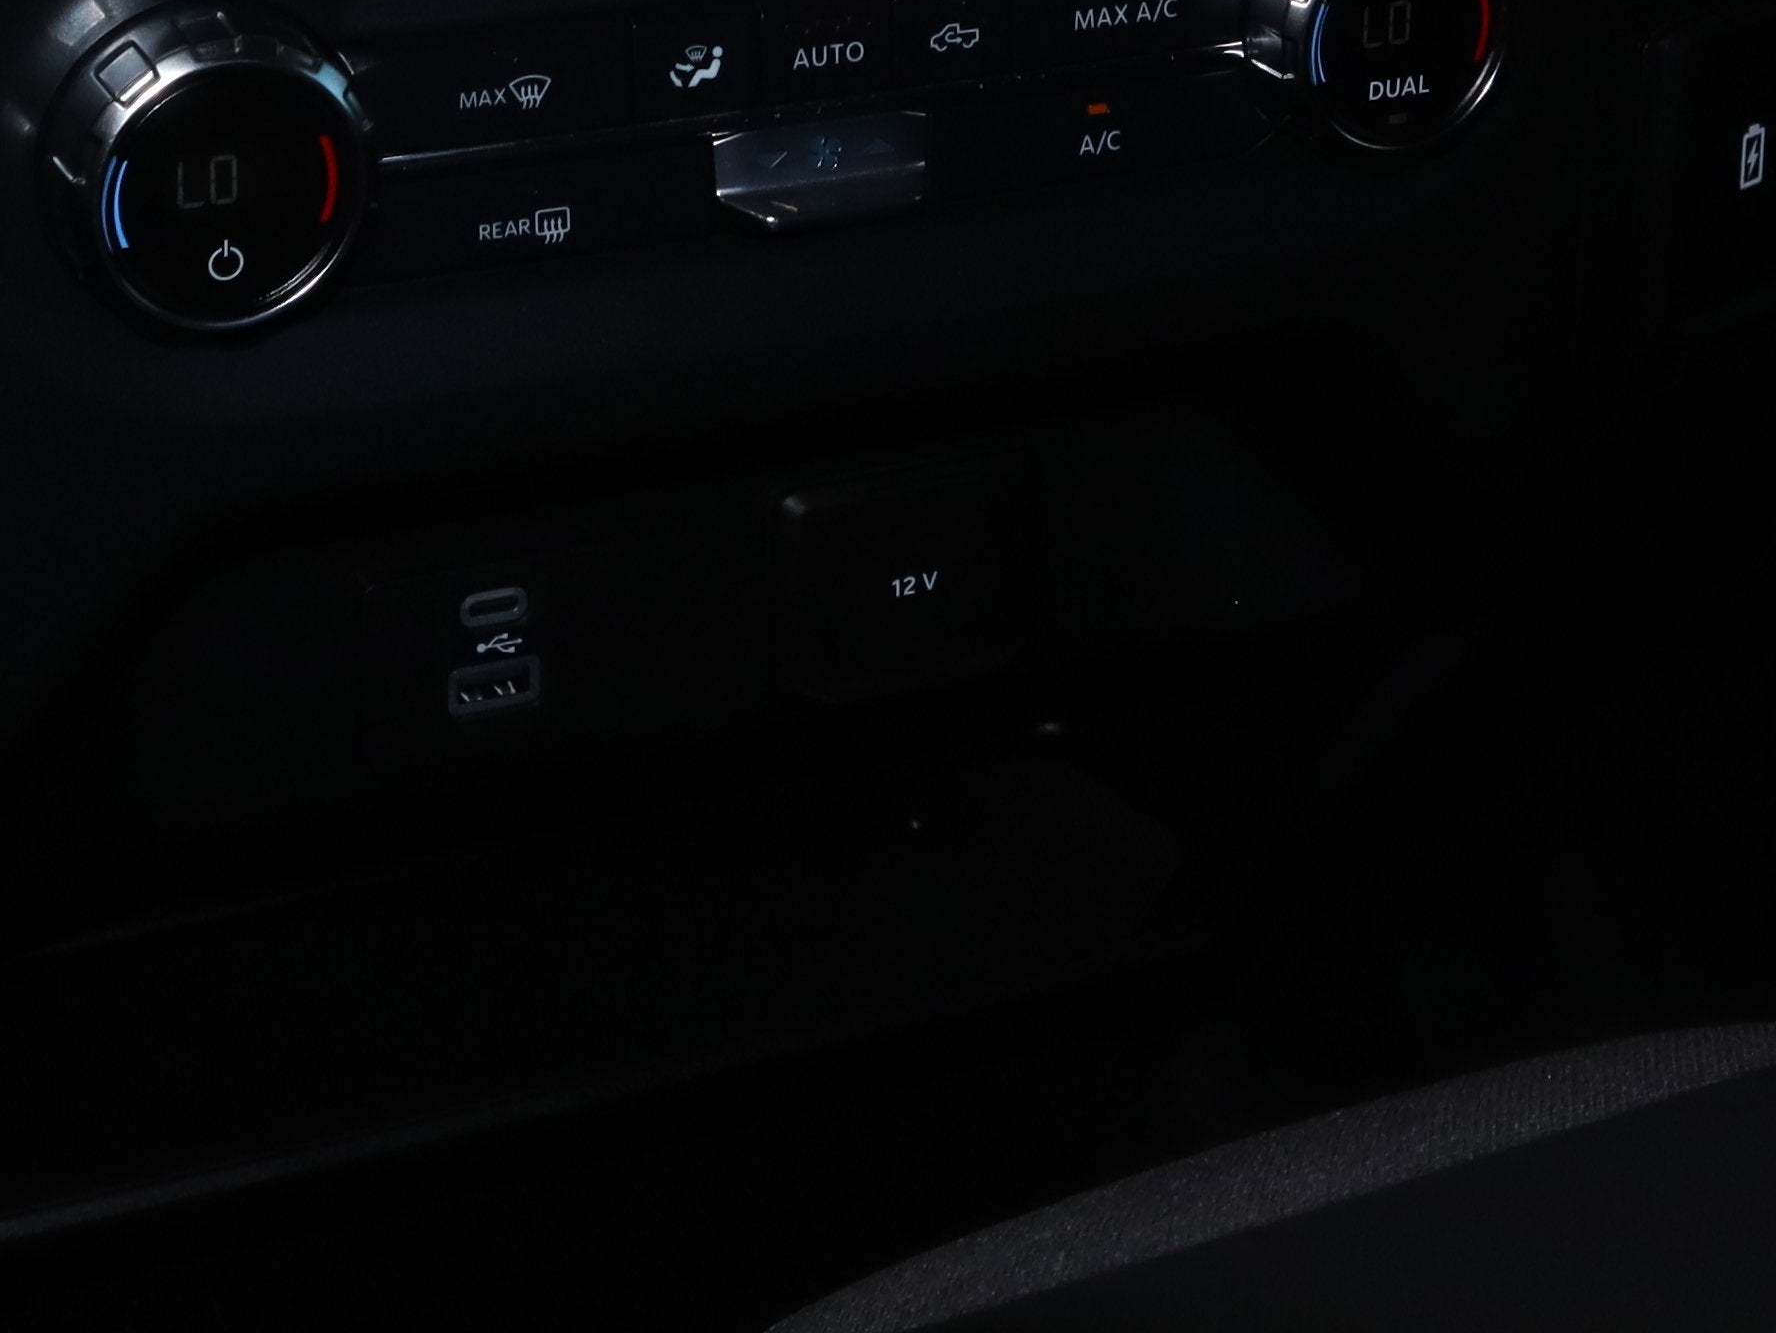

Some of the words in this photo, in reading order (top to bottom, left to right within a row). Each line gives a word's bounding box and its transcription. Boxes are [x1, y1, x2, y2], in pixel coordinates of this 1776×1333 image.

[1073, 4, 1129, 32] MAX
[792, 40, 866, 71] AUTO
[458, 86, 507, 111] MAX
[1367, 78, 1432, 104] DUAL
[1077, 131, 1123, 158] A/C
[477, 218, 532, 243] REAR
